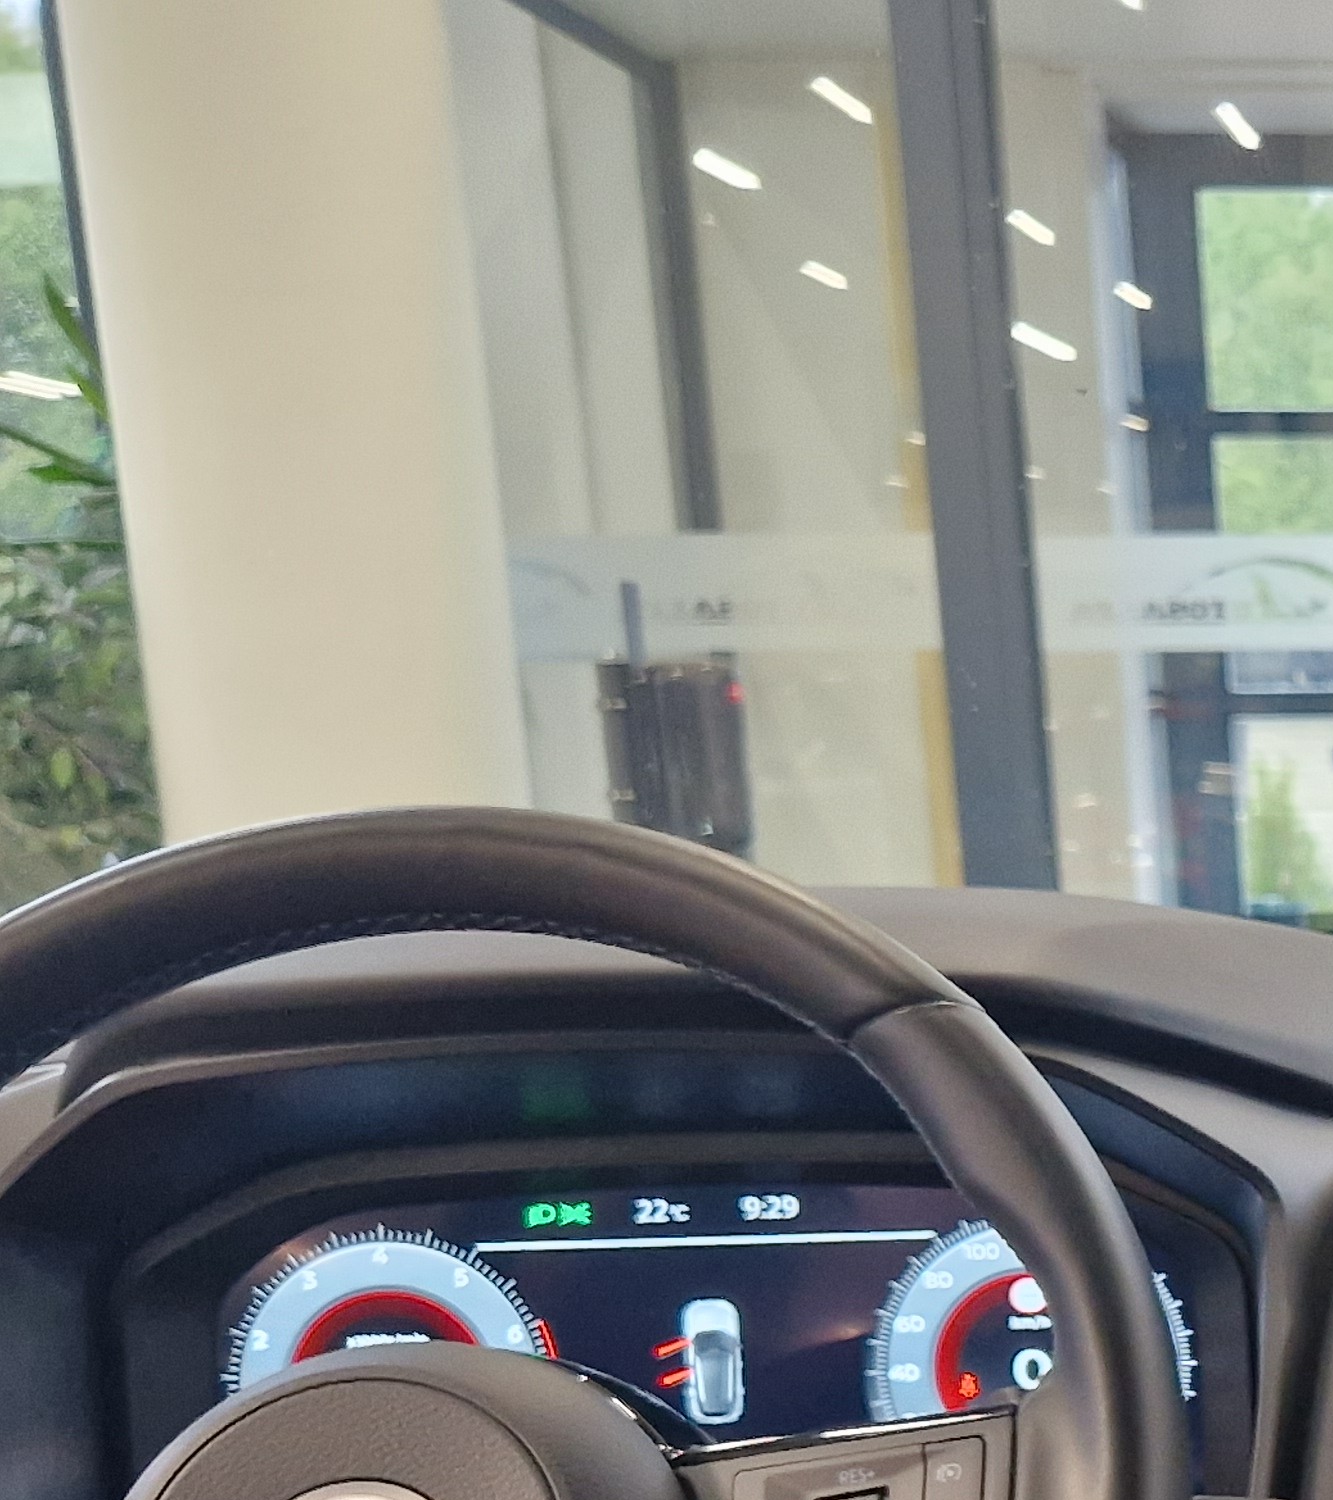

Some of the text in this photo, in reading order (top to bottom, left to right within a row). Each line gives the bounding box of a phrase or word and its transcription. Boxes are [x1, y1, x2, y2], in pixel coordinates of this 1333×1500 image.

[737, 1194, 799, 1221] 9:29
[372, 1249, 389, 1265] 4
[966, 1242, 1000, 1260] 100
[303, 1271, 318, 1291] 3
[453, 1268, 469, 1288] 5
[924, 1271, 953, 1289] 80
[252, 1330, 269, 1351] 2
[507, 1324, 523, 1343] 6
